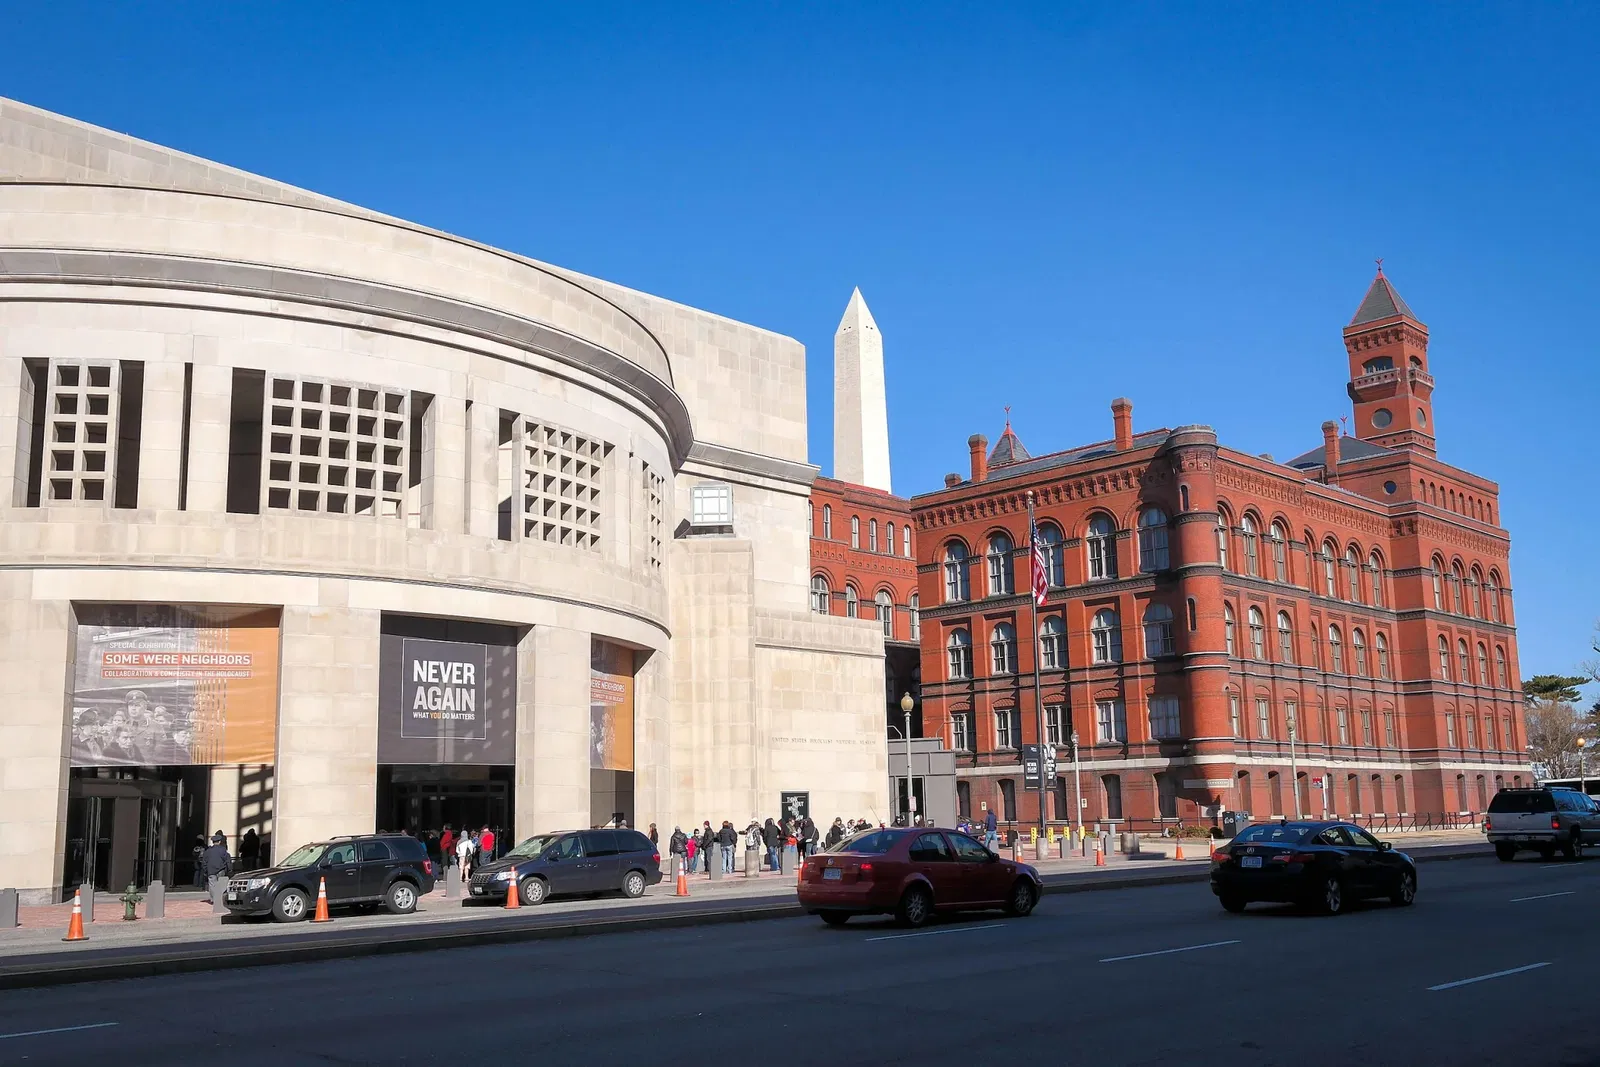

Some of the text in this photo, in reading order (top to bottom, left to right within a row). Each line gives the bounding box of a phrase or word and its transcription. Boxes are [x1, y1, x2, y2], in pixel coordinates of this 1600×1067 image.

[105, 654, 250, 665] SOME WERE NEIGHBORS
[413, 659, 476, 685] NEVER
[413, 685, 476, 712] AGAIN
[413, 711, 476, 721] WHAT YOU DO MATTERS
